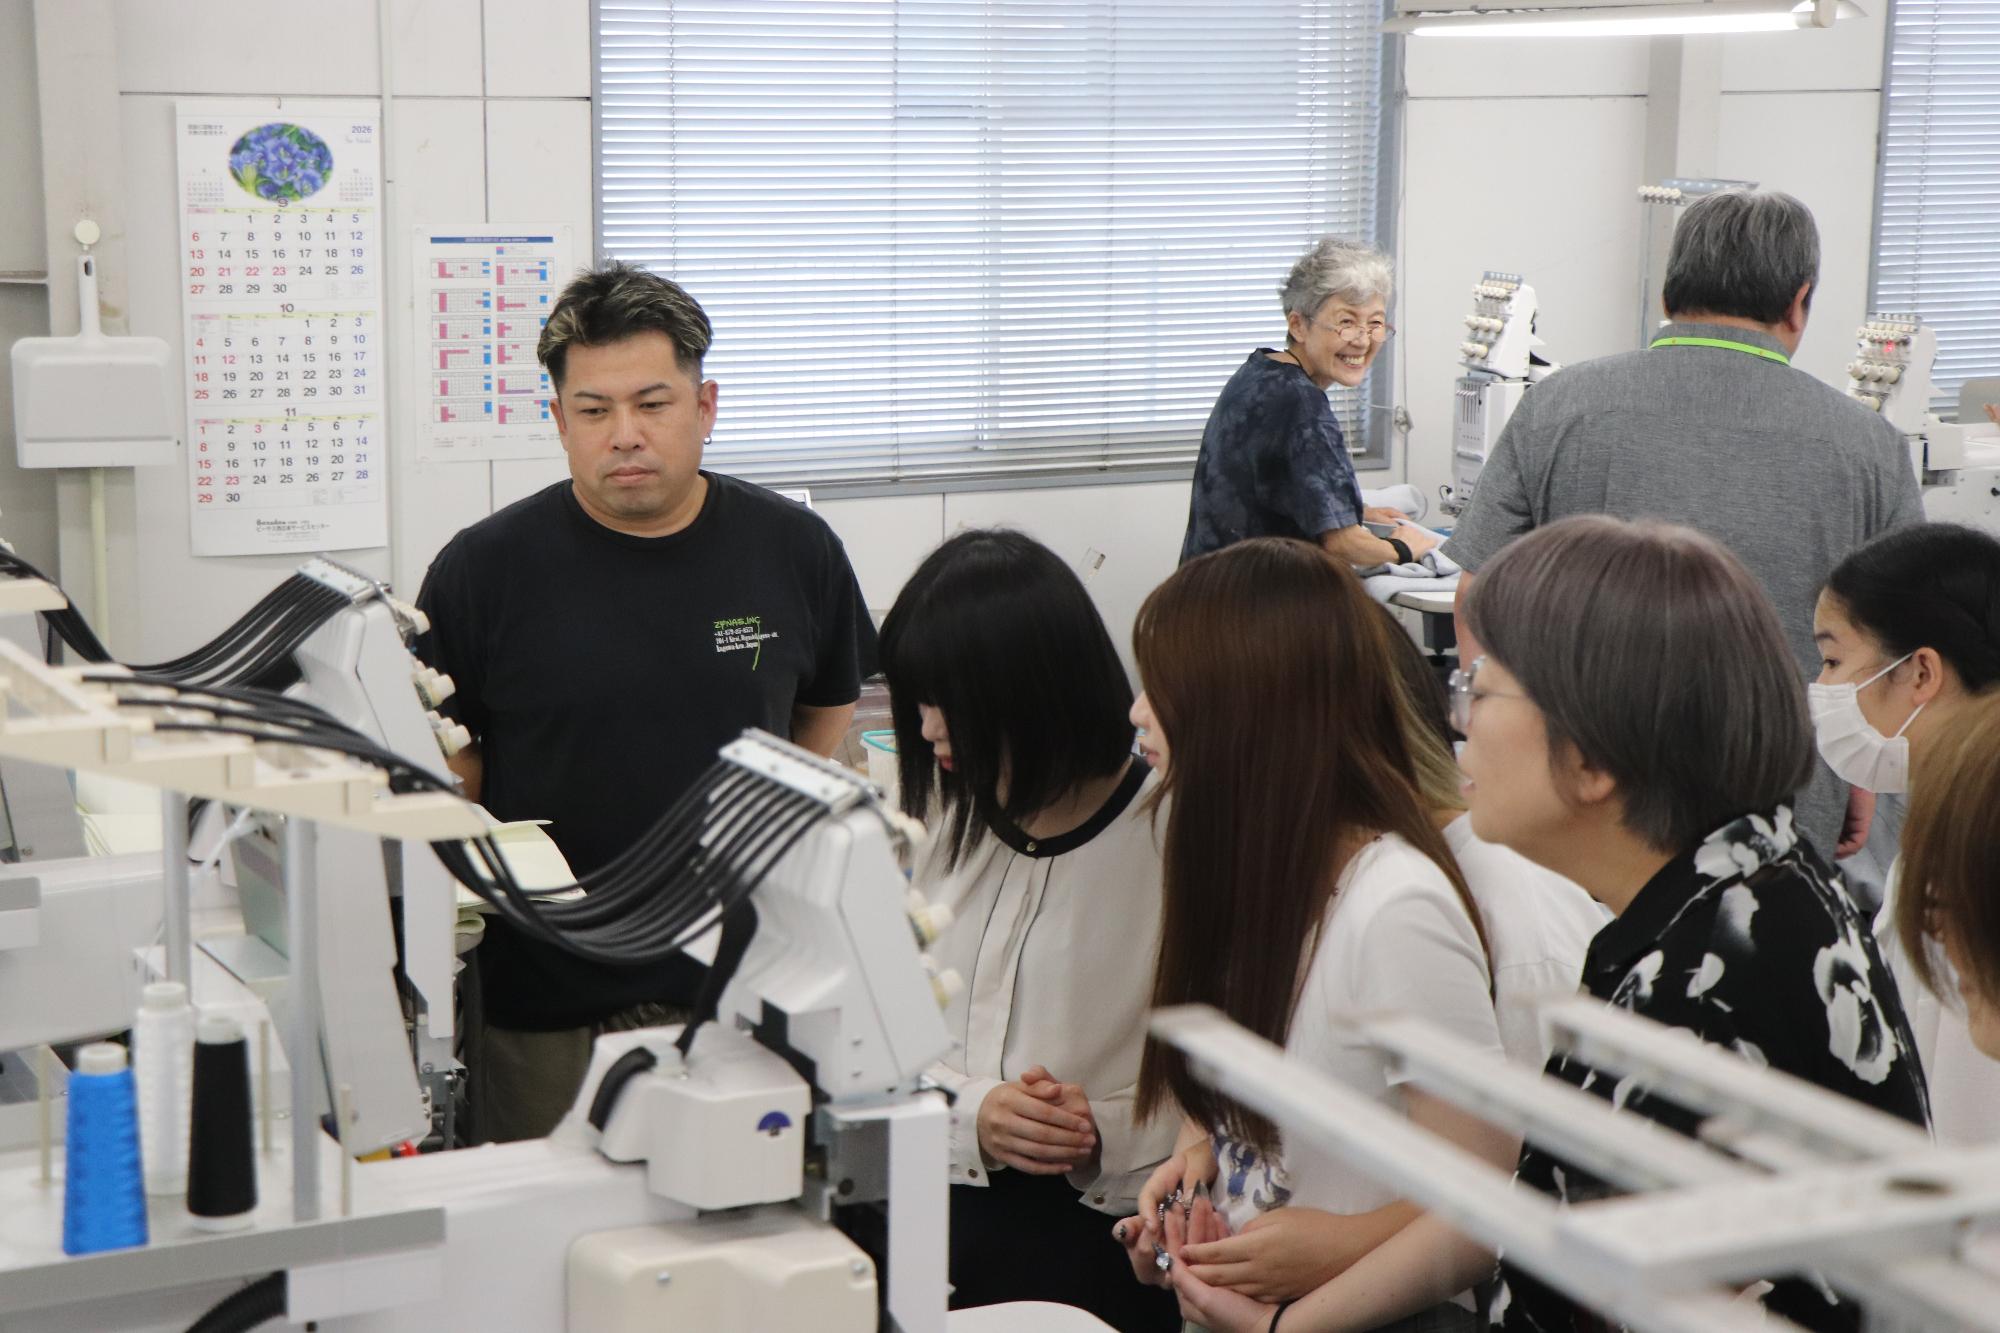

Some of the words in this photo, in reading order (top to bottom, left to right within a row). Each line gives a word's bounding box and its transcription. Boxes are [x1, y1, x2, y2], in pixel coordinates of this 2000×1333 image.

[352, 125, 372, 134] 2026
[278, 199, 288, 208] 9
[247, 214, 252, 223] 1
[274, 214, 281, 224] 2
[300, 214, 307, 224] 3
[326, 214, 333, 223] 4
[352, 214, 359, 223] 5
[192, 232, 200, 242] 6
[220, 232, 228, 241] 7
[247, 232, 255, 241] 8
[274, 232, 282, 241] 9
[298, 231, 311, 241] 10
[325, 231, 336, 240] 11
[350, 231, 363, 240] 12
[190, 249, 204, 259] 13
[218, 250, 231, 259] 14
[245, 249, 259, 259] 15
[272, 249, 286, 259] 16
[299, 249, 312, 258] 17
[325, 248, 338, 258] 18
[351, 248, 363, 258] 19
[190, 267, 205, 277] 20
[218, 267, 231, 277] 21
[245, 266, 260, 276] 22
[272, 266, 286, 276] 23
[299, 266, 312, 275] 24
[325, 265, 338, 275] 25
[351, 265, 364, 274] 26
[191, 284, 205, 294] 27
[219, 284, 233, 294] 28
[246, 284, 260, 293] 29
[273, 283, 287, 293] 30
[280, 303, 294, 314] 10
[305, 319, 310, 328] 1
[330, 318, 337, 328] 2
[355, 317, 362, 327] 3
[196, 338, 204, 347] 4
[224, 338, 232, 347] 5
[251, 337, 259, 347] 6
[278, 336, 286, 346] 7
[305, 336, 312, 345] 8
[330, 335, 338, 345] 9
[353, 334, 366, 344] 10
[194, 355, 206, 364] 11
[222, 355, 236, 365] 12
[250, 354, 263, 364] 13
[277, 354, 289, 363] 14
[303, 353, 316, 362] 15
[329, 352, 341, 361] 16
[354, 351, 366, 360] 17
[195, 372, 209, 382] 18
[223, 372, 236, 382] 19
[249, 371, 264, 381] 20
[276, 371, 288, 380] 21
[303, 370, 316, 379] 22
[328, 369, 342, 379] 23
[353, 368, 366, 378] 24
[194, 389, 209, 399] 25
[223, 389, 237, 399] 26
[250, 388, 264, 398] 27
[277, 388, 290, 398] 28
[303, 387, 317, 397] 29
[329, 386, 342, 396] 30
[354, 385, 365, 395] 31
[285, 408, 297, 417] 11
[200, 426, 205, 434] 1
[227, 424, 235, 434] 2
[255, 424, 262, 434] 3
[281, 423, 288, 432] 4
[308, 422, 314, 432] 5
[333, 421, 340, 430] 6
[358, 419, 364, 429] 7
[200, 442, 207, 452] 8
[227, 442, 235, 451] 9
[252, 441, 266, 450] 10
[280, 440, 290, 449] 11
[305, 439, 318, 448] 12
[331, 438, 343, 447] 13
[356, 436, 368, 445] 14
[198, 459, 212, 469] 15
[225, 459, 239, 468] 16
[253, 458, 266, 467] 17
[280, 457, 293, 466] 18
[306, 456, 319, 465] 19
[331, 454, 344, 464] 20
[355, 453, 367, 463] 21
[198, 476, 212, 486] 22
[226, 476, 240, 485] 23
[253, 475, 266, 485] 24
[280, 474, 293, 484] 25
[306, 473, 319, 482] 26
[331, 471, 344, 481] 27
[356, 470, 368, 479] 28
[198, 493, 213, 503] 29
[226, 493, 240, 503] 30
